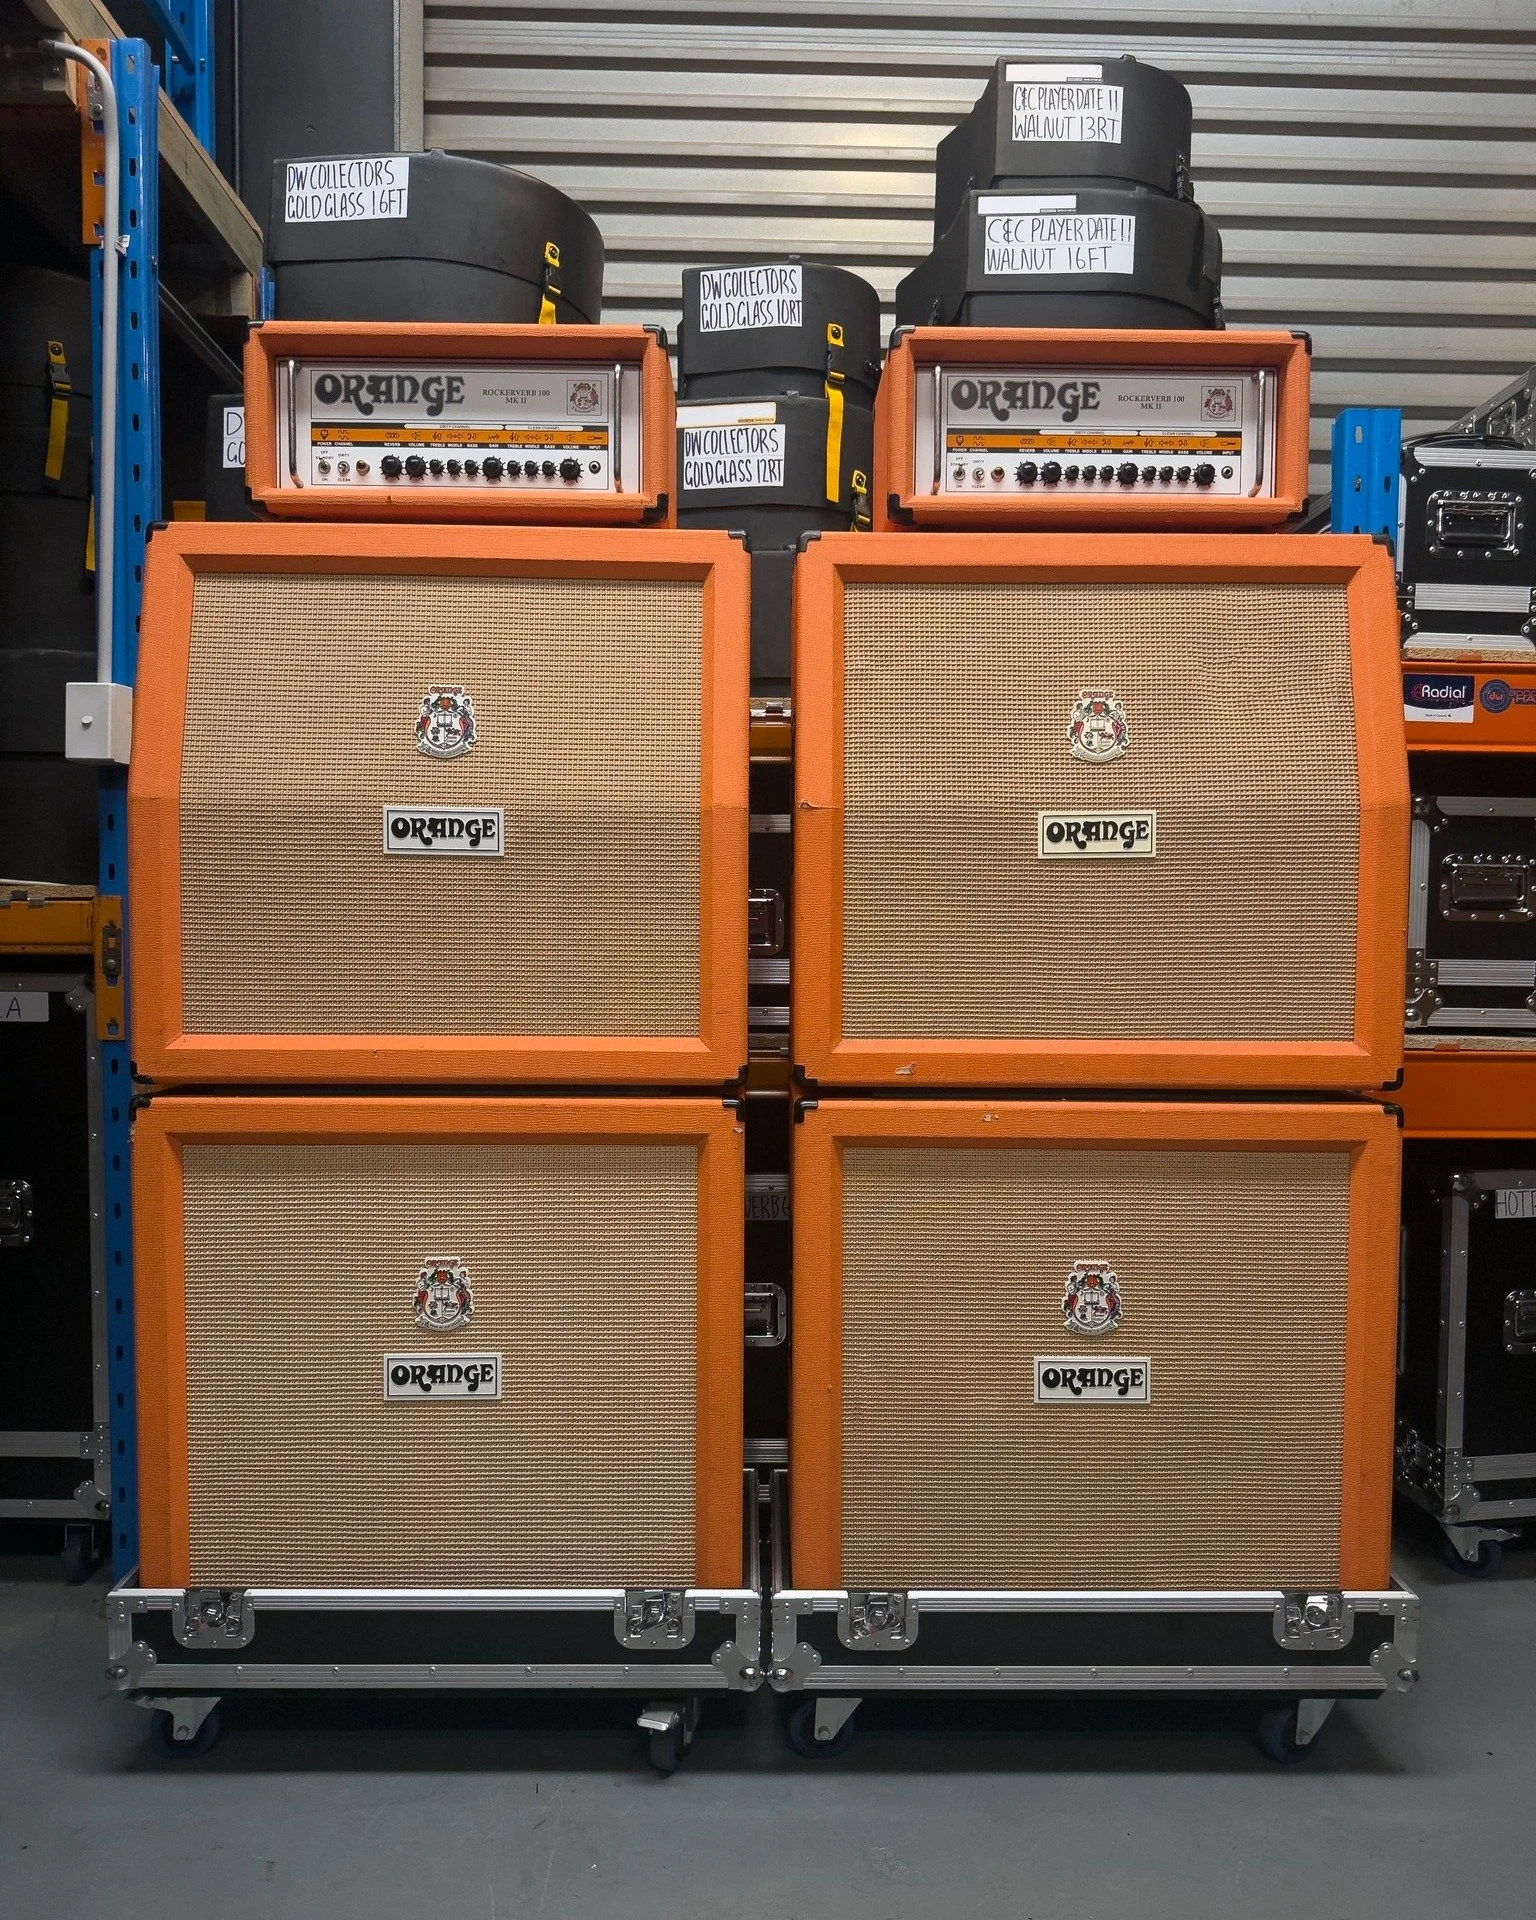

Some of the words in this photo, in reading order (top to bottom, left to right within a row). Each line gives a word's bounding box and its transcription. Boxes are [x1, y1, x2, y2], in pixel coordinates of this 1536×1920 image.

[1014, 86, 1035, 111] C&C
[1037, 86, 1075, 111] PLAYER
[1077, 87, 1104, 111] DATE
[1013, 114, 1076, 139] WALNUT
[1080, 117, 1120, 141] 13RT
[310, 160, 395, 189] COLLECTORS
[287, 195, 322, 219] GOLD
[324, 192, 365, 218] GLASS
[987, 218, 1025, 244] C&C
[1031, 218, 1084, 243] PLAYER
[1087, 217, 1117, 242] DATE
[987, 247, 1056, 271] WALNUT
[1068, 246, 1112, 270] 16FT
[723, 268, 797, 298] COLLECTORS
[701, 301, 735, 329] GOLD
[737, 300, 774, 326] GLASS
[314, 373, 466, 417] ORANGE
[482, 389, 537, 397] ROCKERVERB
[538, 389, 551, 397] 100
[951, 379, 1101, 422] ORANGE
[1173, 395, 1185, 403] 100
[703, 428, 779, 455] COLLECTORS
[685, 461, 714, 487] GOLD
[715, 459, 752, 484] GLASS
[756, 458, 783, 484] 12RT
[430, 686, 463, 696] ORANGE
[1081, 690, 1114, 701] ORANGE
[1421, 684, 1466, 699] Radial
[391, 817, 496, 847] ORANGE
[1046, 820, 1150, 850] ORANGE
[390, 1363, 494, 1392] ORANGE
[1042, 1367, 1144, 1396] ORANGE
